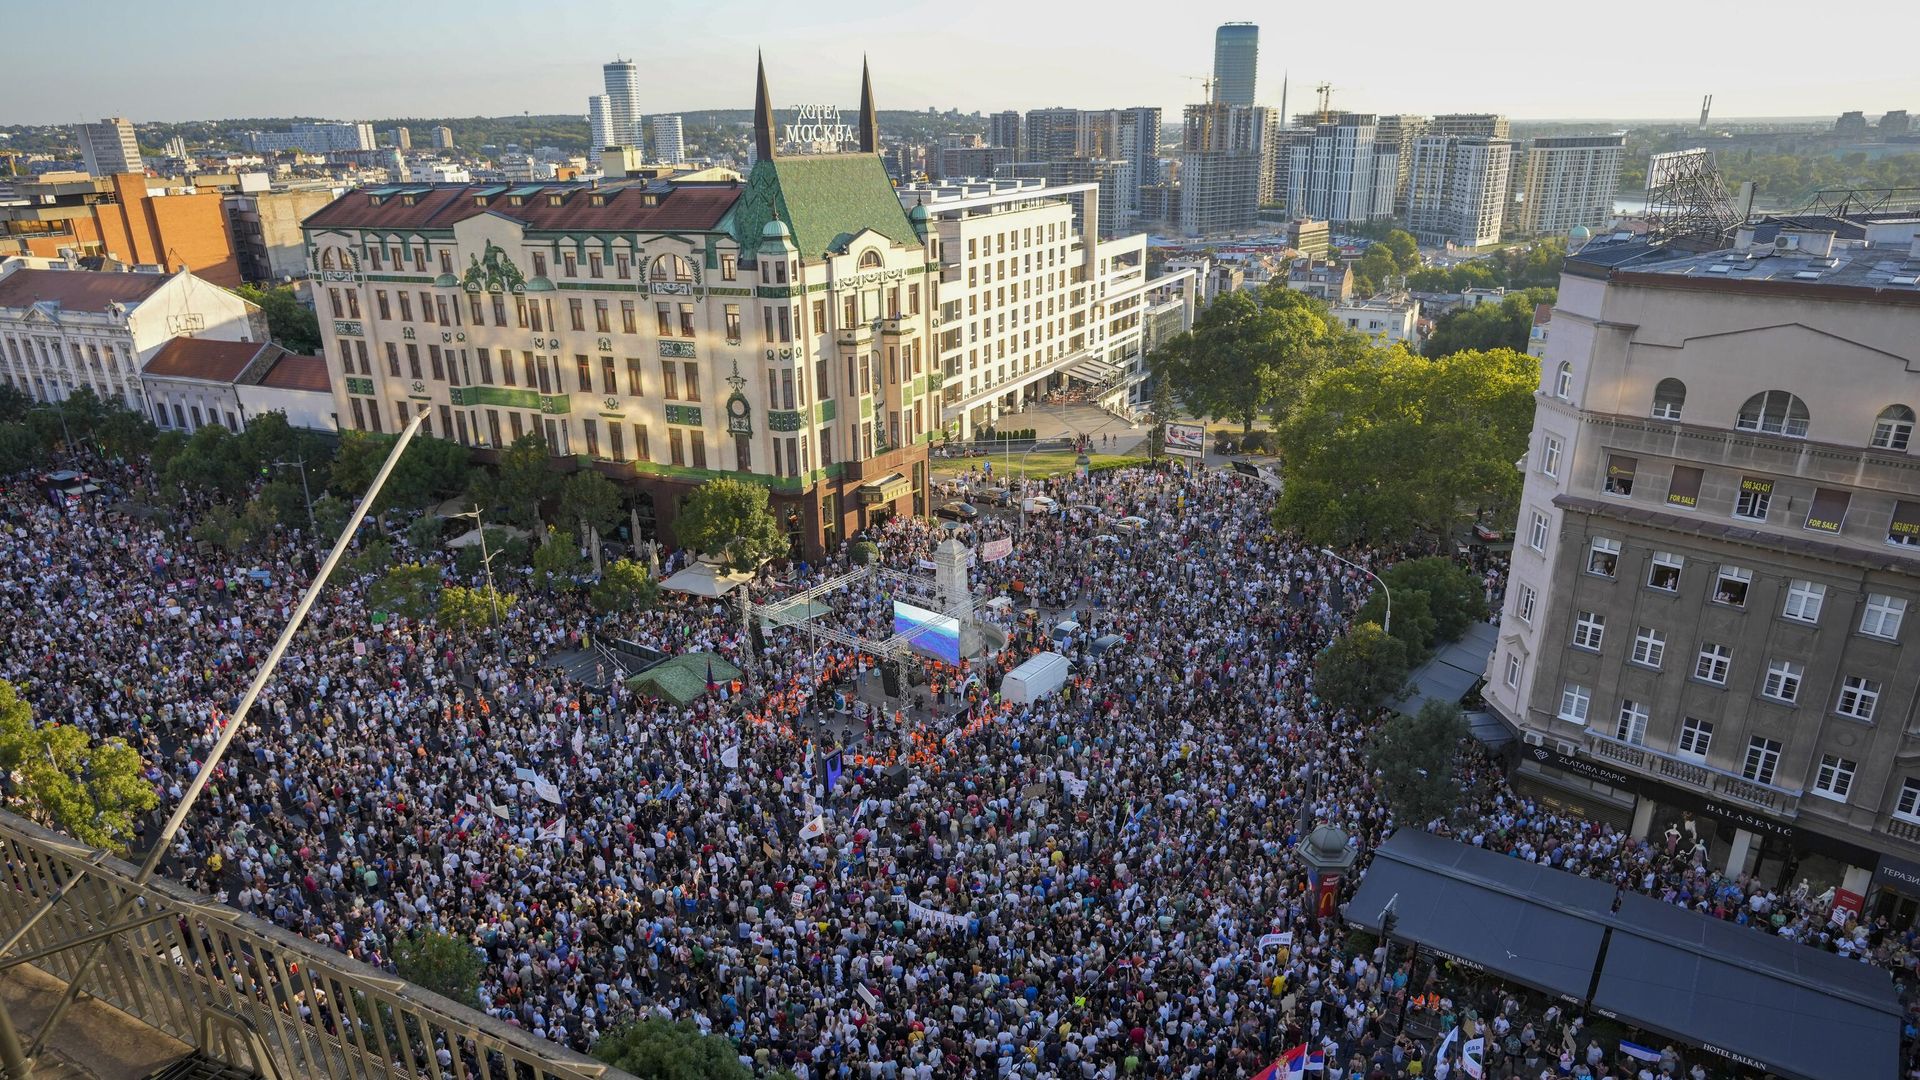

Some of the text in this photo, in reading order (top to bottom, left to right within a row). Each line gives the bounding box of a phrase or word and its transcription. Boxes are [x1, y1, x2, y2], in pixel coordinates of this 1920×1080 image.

[798, 104, 840, 119] ХОТЕЛ
[786, 125, 854, 142] МОСКВА
[1669, 494, 1695, 505] FOR SALE
[1808, 518, 1838, 531] FOR SALE
[1559, 756, 1626, 783] ZLATARA PAPIĆ
[1706, 804, 1793, 837] BALAŠEVIĆ
[1883, 866, 1920, 886] ТЕРАЗИ
[1456, 957, 1484, 971] BALKAN
[1703, 1043, 1767, 1070] HOTEL BALKAN
